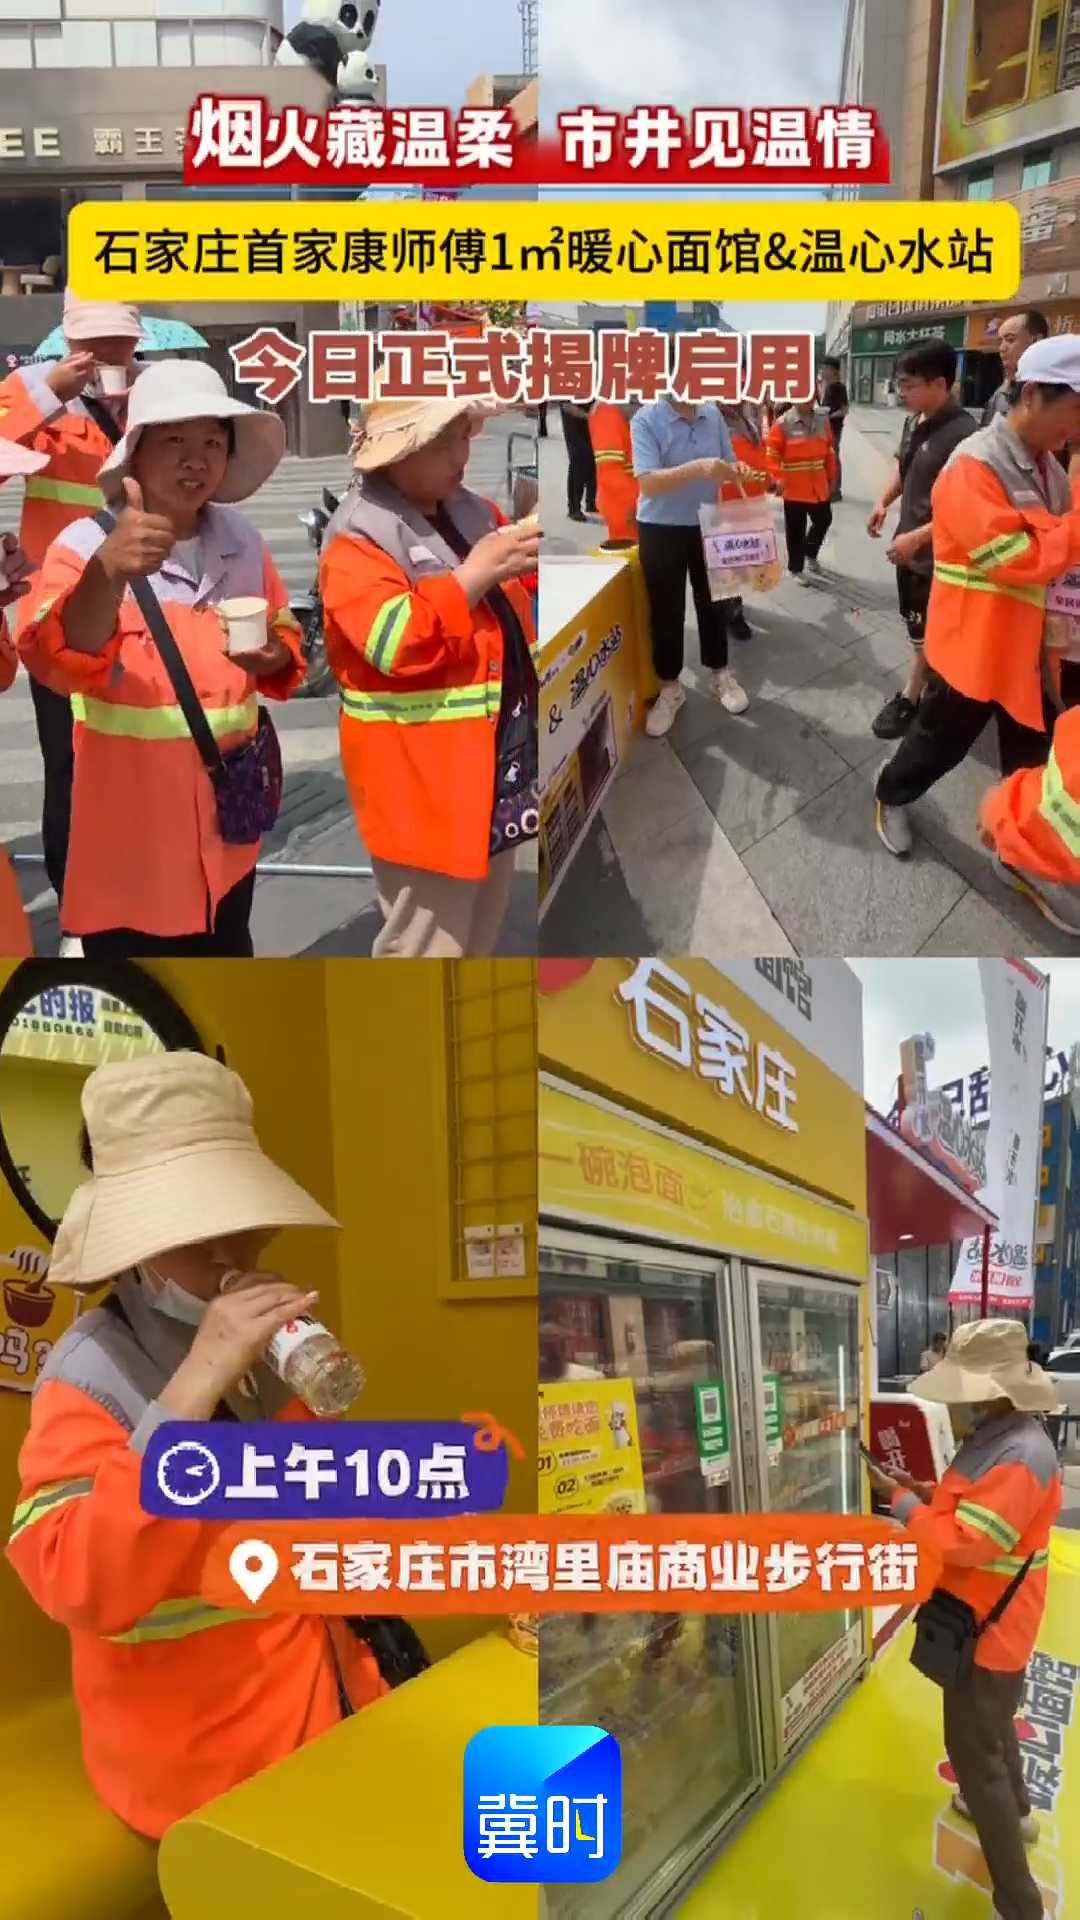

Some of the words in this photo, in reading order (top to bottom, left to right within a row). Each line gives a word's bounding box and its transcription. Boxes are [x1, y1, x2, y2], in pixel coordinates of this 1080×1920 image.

[617, 957, 799, 1134] 石家庄
[556, 1478, 577, 1495] 02
